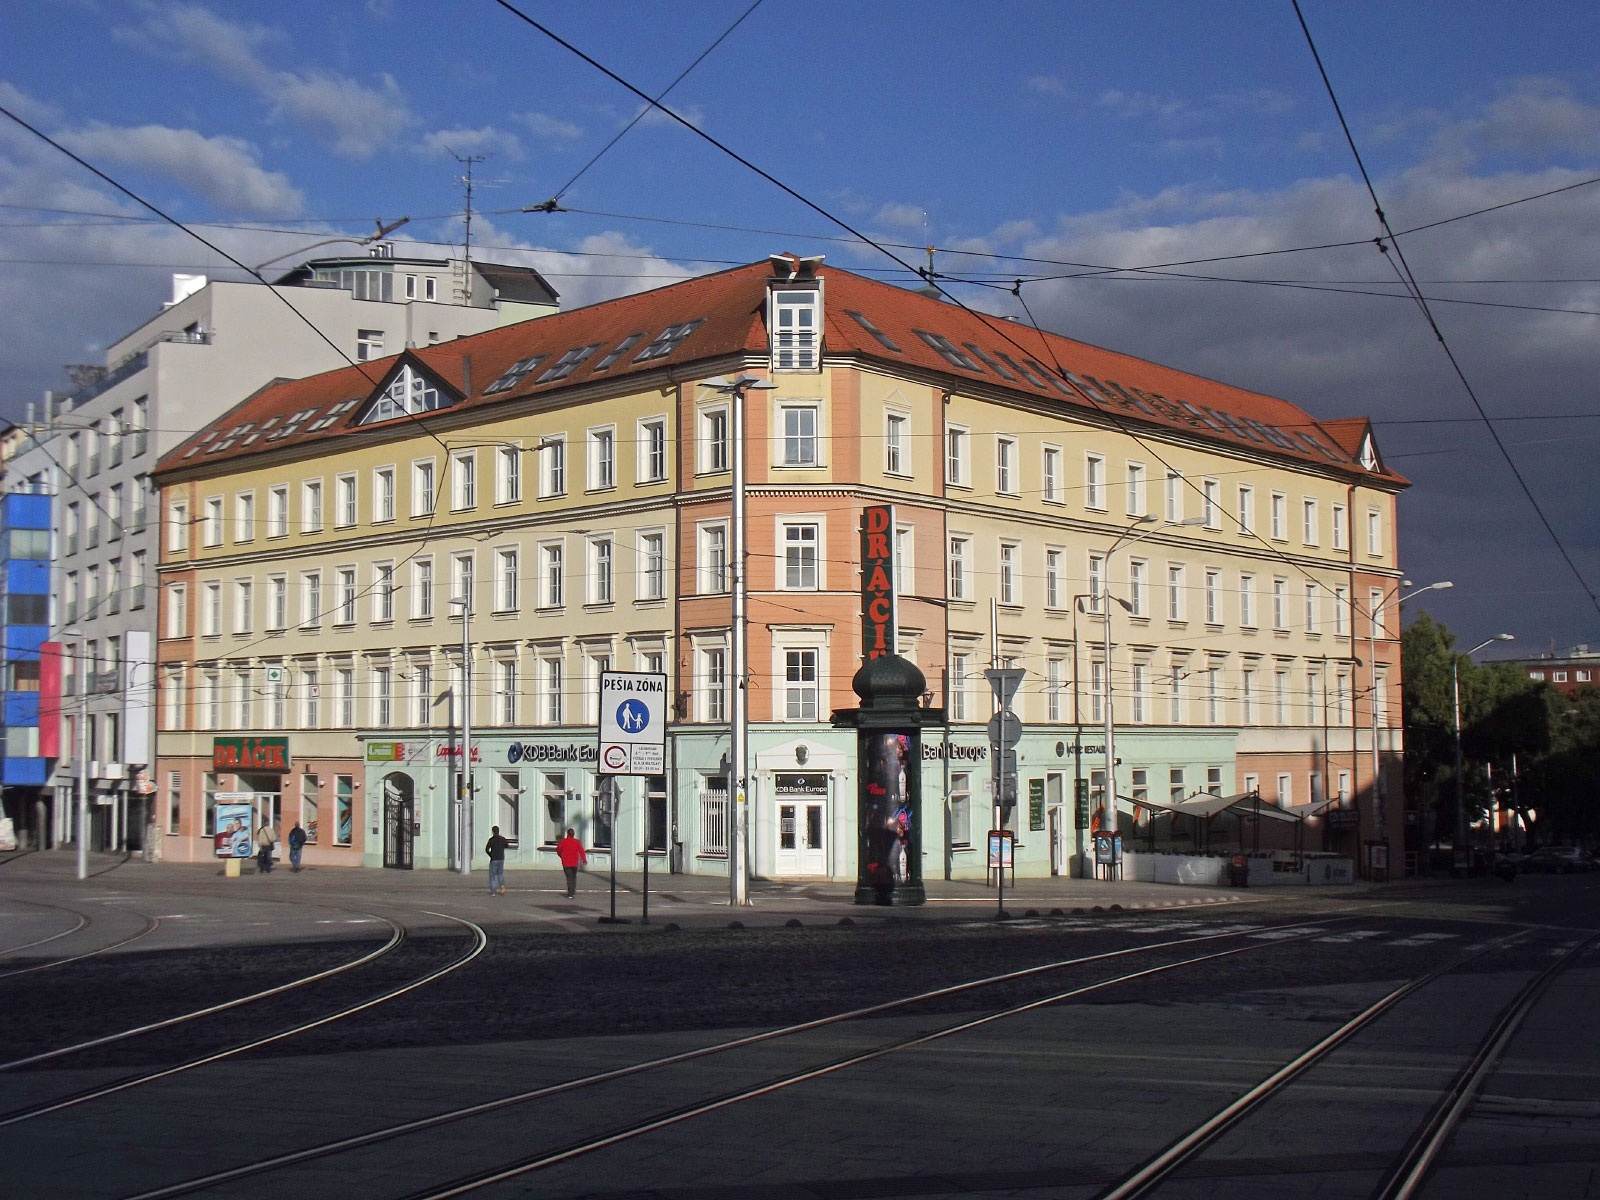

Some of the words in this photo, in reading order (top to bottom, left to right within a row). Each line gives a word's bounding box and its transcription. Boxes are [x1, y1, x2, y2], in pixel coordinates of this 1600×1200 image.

[604, 677, 633, 691] PEŠIA
[636, 678, 663, 692] ZÓNA
[214, 739, 286, 768] DRÁČIK
[522, 745, 548, 761] KDB
[548, 744, 578, 761] Bank
[579, 745, 599, 761] Eur
[949, 743, 986, 762] Europe
[790, 785, 804, 793] Bank
[806, 785, 827, 793] Europe
